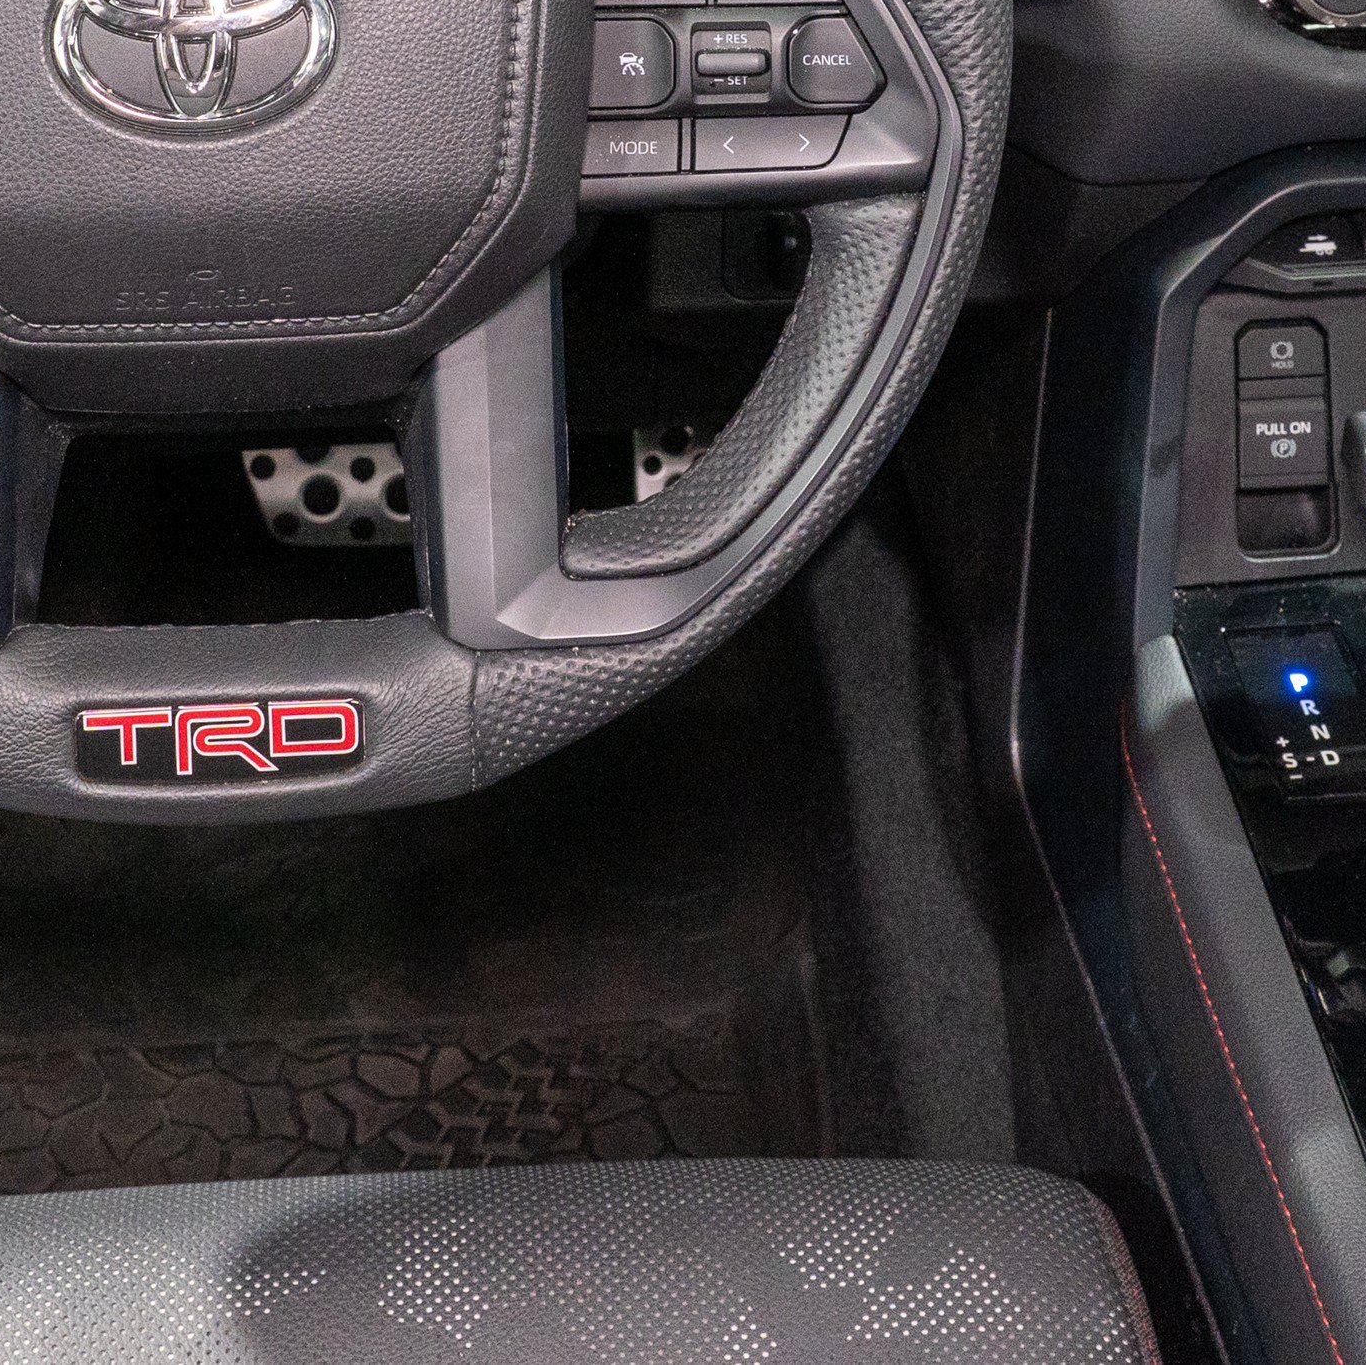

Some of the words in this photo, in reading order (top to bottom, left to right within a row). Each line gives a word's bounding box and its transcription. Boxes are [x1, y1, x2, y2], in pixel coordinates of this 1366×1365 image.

[725, 33, 748, 44] RES
[802, 54, 852, 66] CANCEL
[727, 75, 748, 86] SET
[609, 141, 658, 155] MODE
[116, 291, 170, 310] SRS
[1255, 422, 1287, 436] PULL
[1289, 421, 1312, 435] ON
[1289, 673, 1309, 692] P
[1300, 699, 1320, 715] R
[83, 701, 360, 776] TRD
[1310, 724, 1331, 740] N
[1282, 752, 1298, 769] S
[1320, 749, 1340, 766] D
